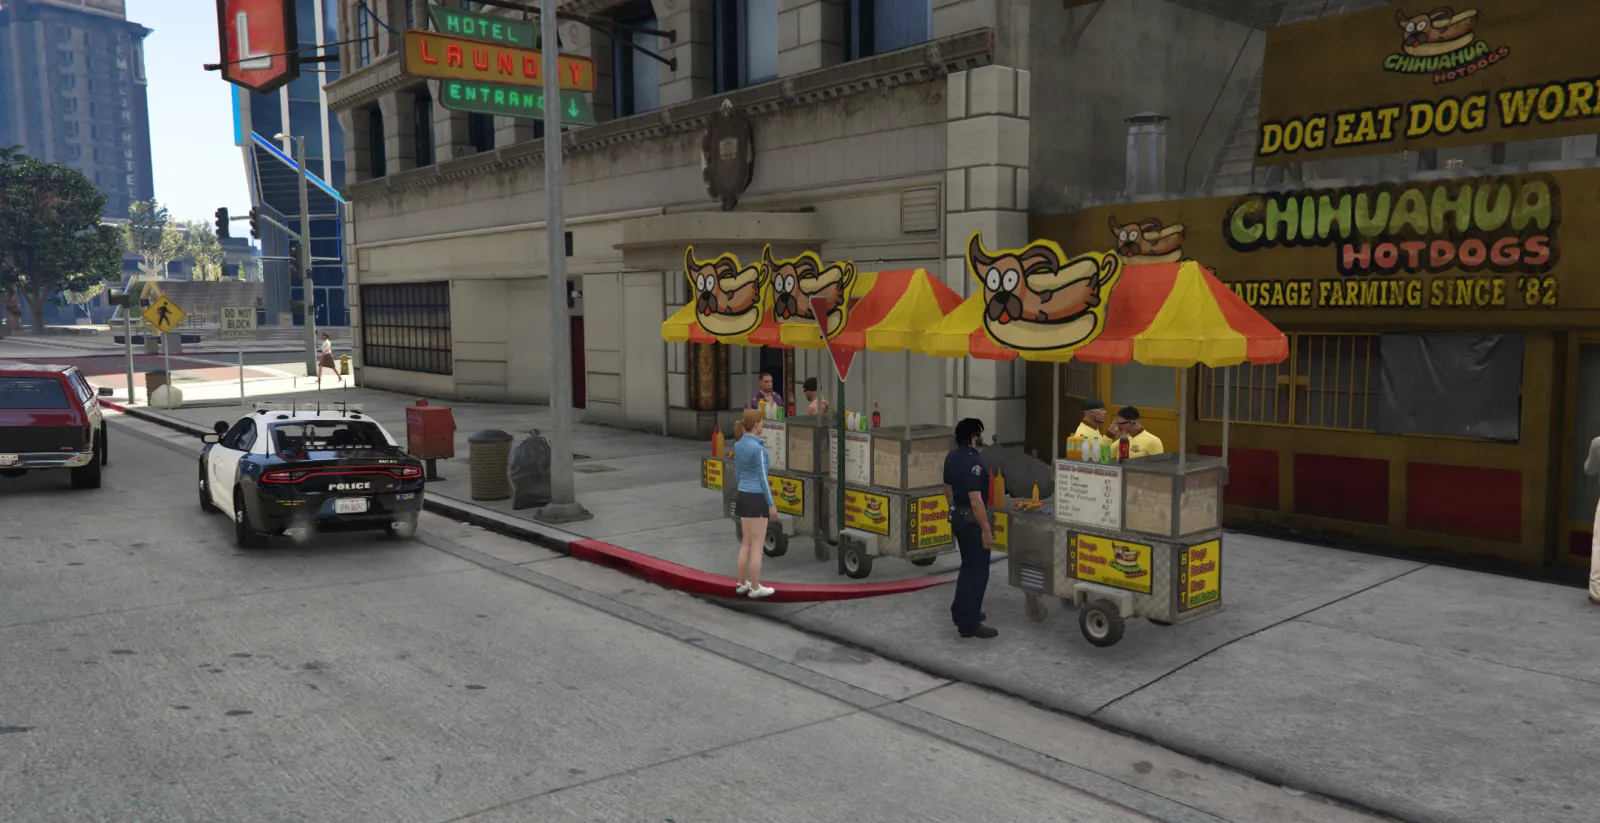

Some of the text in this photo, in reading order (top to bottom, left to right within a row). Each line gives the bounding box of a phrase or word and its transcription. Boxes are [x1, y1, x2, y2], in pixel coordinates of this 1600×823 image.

[236, 12, 272, 70] L
[447, 15, 518, 43] HOTEL
[420, 40, 583, 85] LAUNDY
[1384, 40, 1490, 73] CHIHUAHUA
[1433, 46, 1510, 84] HOTDOGS
[449, 83, 545, 110] ENTRANC
[1259, 117, 1327, 156] DOG
[1334, 104, 1401, 146] EAT
[1407, 95, 1488, 137] DOG
[1229, 180, 1552, 245] CHIHUAHUA
[1341, 235, 1551, 270] HOTDOGS
[1223, 276, 1558, 307] AUSAGE FARMING SINCE '82
[224, 308, 252, 318] DO NOT
[227, 319, 251, 329] BLOCK
[328, 481, 371, 491] POLICE
[920, 499, 939, 510] Dogs
[920, 525, 938, 535] Nuts
[1078, 539, 1098, 552] Dogs
[1069, 538, 1077, 572] HOT
[1190, 548, 1208, 562] Dogs
[1180, 552, 1188, 604] HOT
